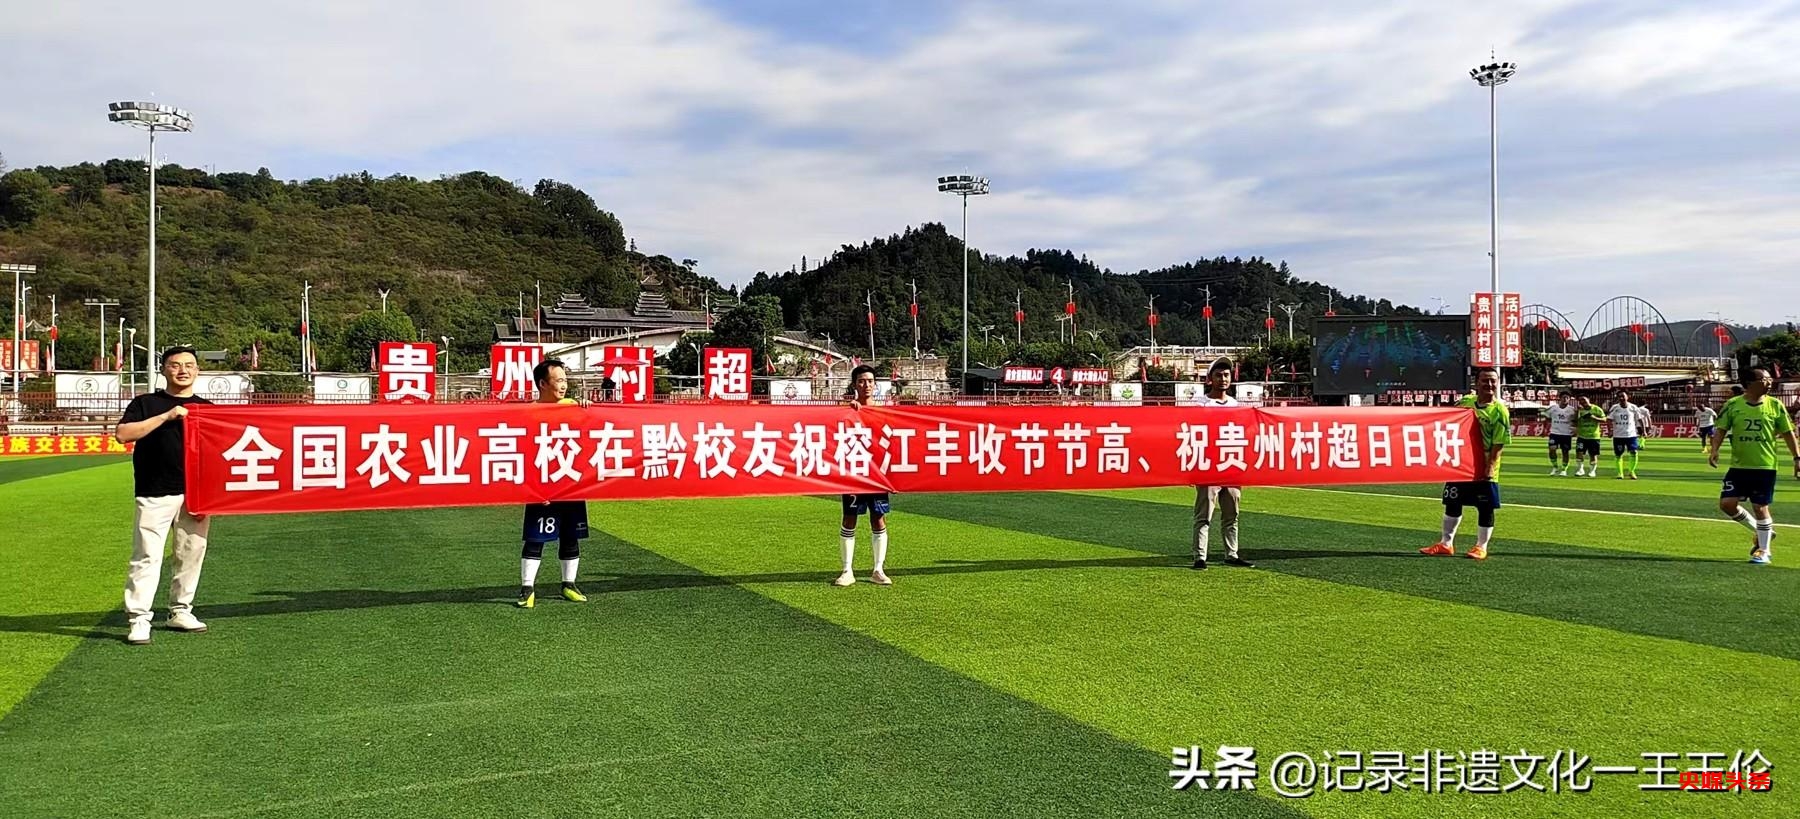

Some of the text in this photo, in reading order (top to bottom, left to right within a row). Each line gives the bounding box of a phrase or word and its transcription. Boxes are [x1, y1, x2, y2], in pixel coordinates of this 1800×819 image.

[1477, 297, 1492, 363] 贵州村超
[1505, 297, 1519, 364] 活力四射
[382, 344, 749, 400] 贵州村超
[1053, 368, 1063, 382] 4
[1603, 379, 1612, 390] 5
[1744, 419, 1762, 431] 25
[0, 436, 127, 453] 族交往交流
[222, 420, 1464, 492] 全国农业高校在黔校友祝榕江丰收节节高、祝贵州村超日日好
[537, 517, 555, 534] 18
